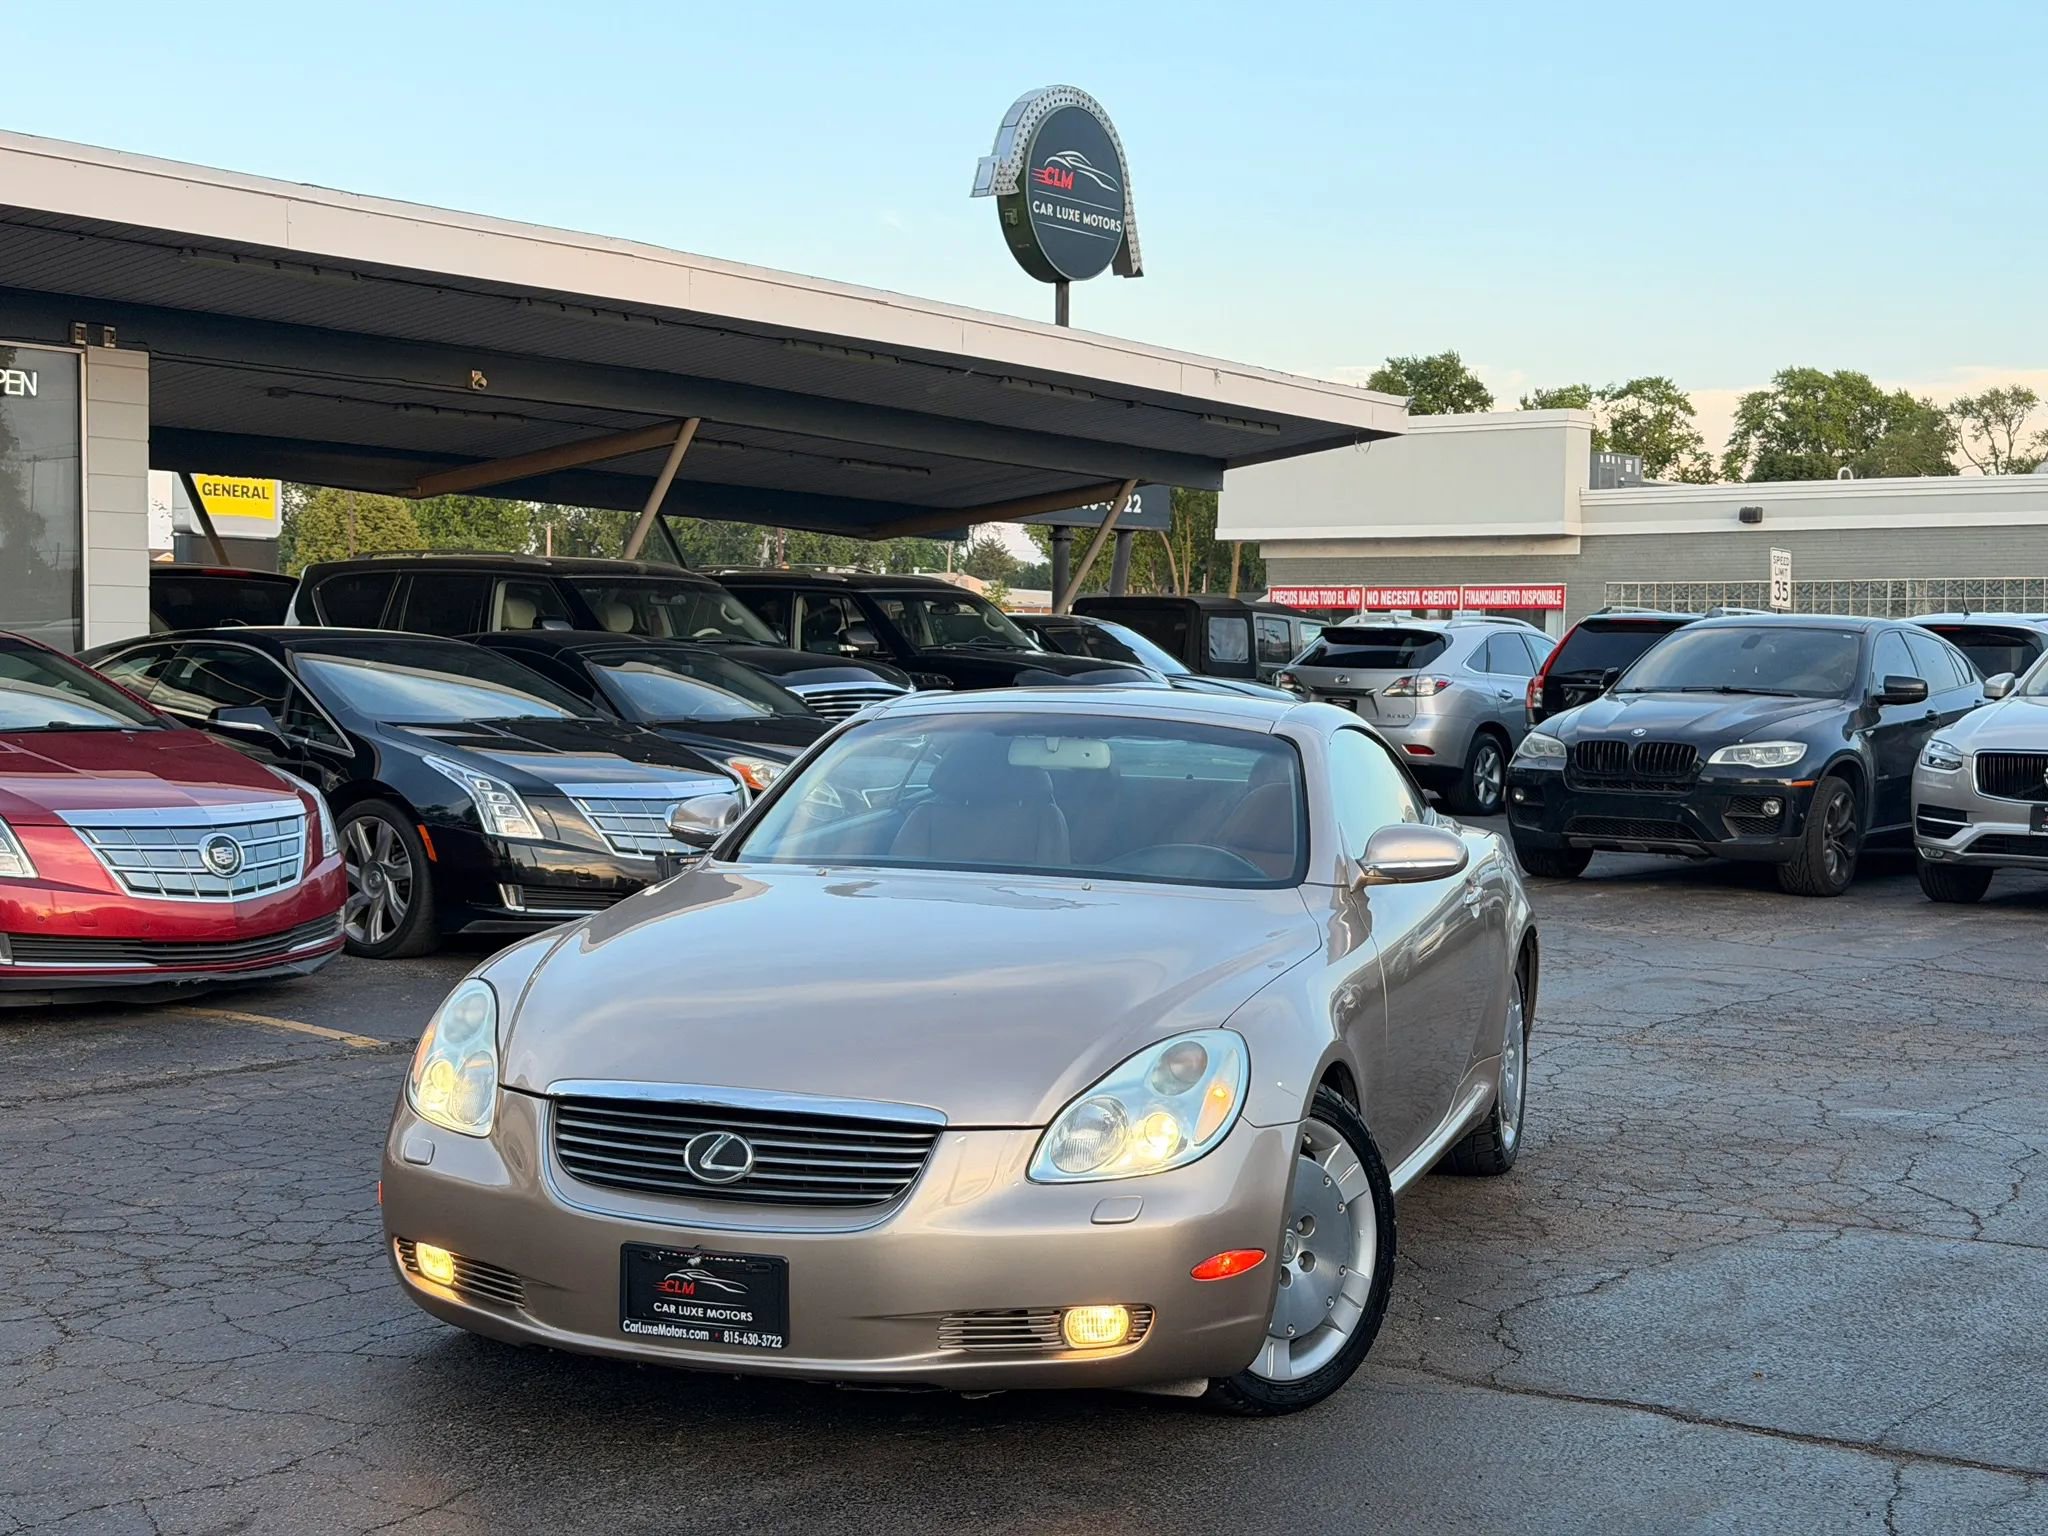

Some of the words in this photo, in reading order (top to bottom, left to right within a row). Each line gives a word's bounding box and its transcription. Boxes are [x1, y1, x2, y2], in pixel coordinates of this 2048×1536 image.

[1044, 166, 1075, 190] CLM
[1032, 200, 1054, 217] CAR
[1056, 205, 1080, 224] LUXE
[1083, 212, 1122, 233] MOTORS
[202, 482, 270, 500] GENERAL
[1773, 555, 1789, 566] SPEED
[1774, 567, 1788, 576] LIMIT
[1271, 590, 1298, 605] PRECIOS
[1298, 590, 1319, 605] BAJOS
[1319, 590, 1337, 605] TODO
[1337, 590, 1346, 605] EL
[1346, 589, 1360, 605] AÑO
[1366, 590, 1379, 605] NO
[1380, 590, 1420, 605] NECESITA
[1422, 590, 1458, 605] CREDITO
[1464, 590, 1520, 605] FINANCIAMIENTO
[1521, 589, 1562, 605] DISPONIBLE
[1774, 580, 1789, 602] 35
[664, 1279, 696, 1296] CLM
[653, 1302, 676, 1314] CAR
[678, 1305, 704, 1318] LUXE
[706, 1308, 753, 1322] MOTORS
[622, 1320, 710, 1341] CarLuxeMotors.com
[723, 1330, 783, 1349] 815-630-3722
